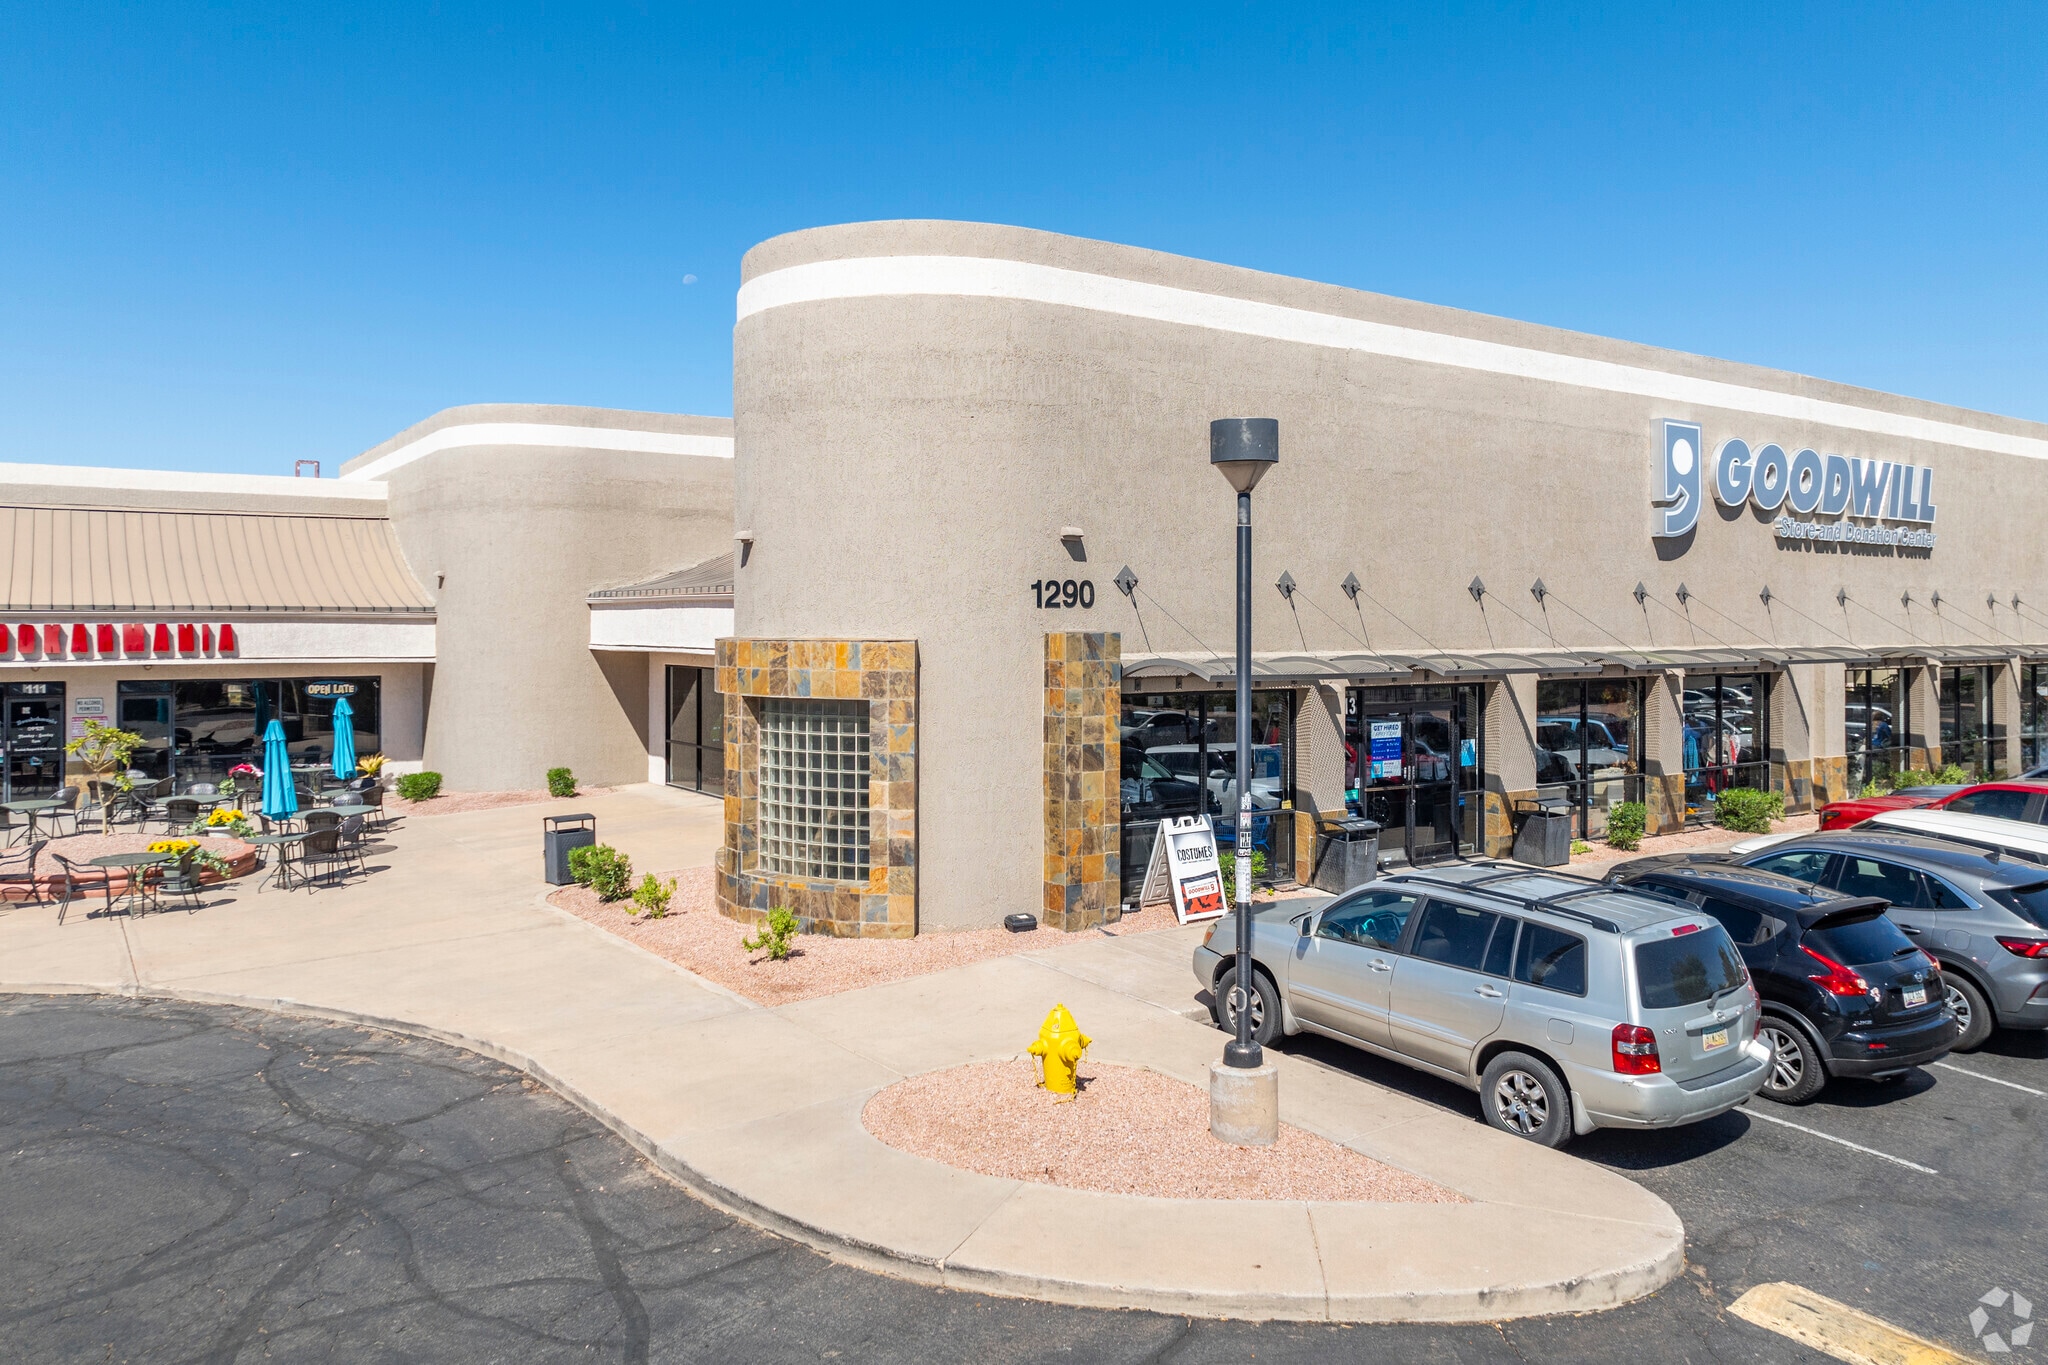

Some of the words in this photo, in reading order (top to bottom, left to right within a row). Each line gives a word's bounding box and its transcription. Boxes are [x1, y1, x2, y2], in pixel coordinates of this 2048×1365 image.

[1711, 438, 1937, 523] GOODWILL
[1779, 517, 1816, 538] Store
[1818, 522, 1841, 541] and
[1846, 522, 1899, 545] Donation
[1901, 527, 1937, 548] Center
[1031, 579, 1095, 609] 1290
[308, 684, 330, 694] OPEN
[333, 684, 354, 693] LATE
[1177, 845, 1213, 861] COSTUMES
